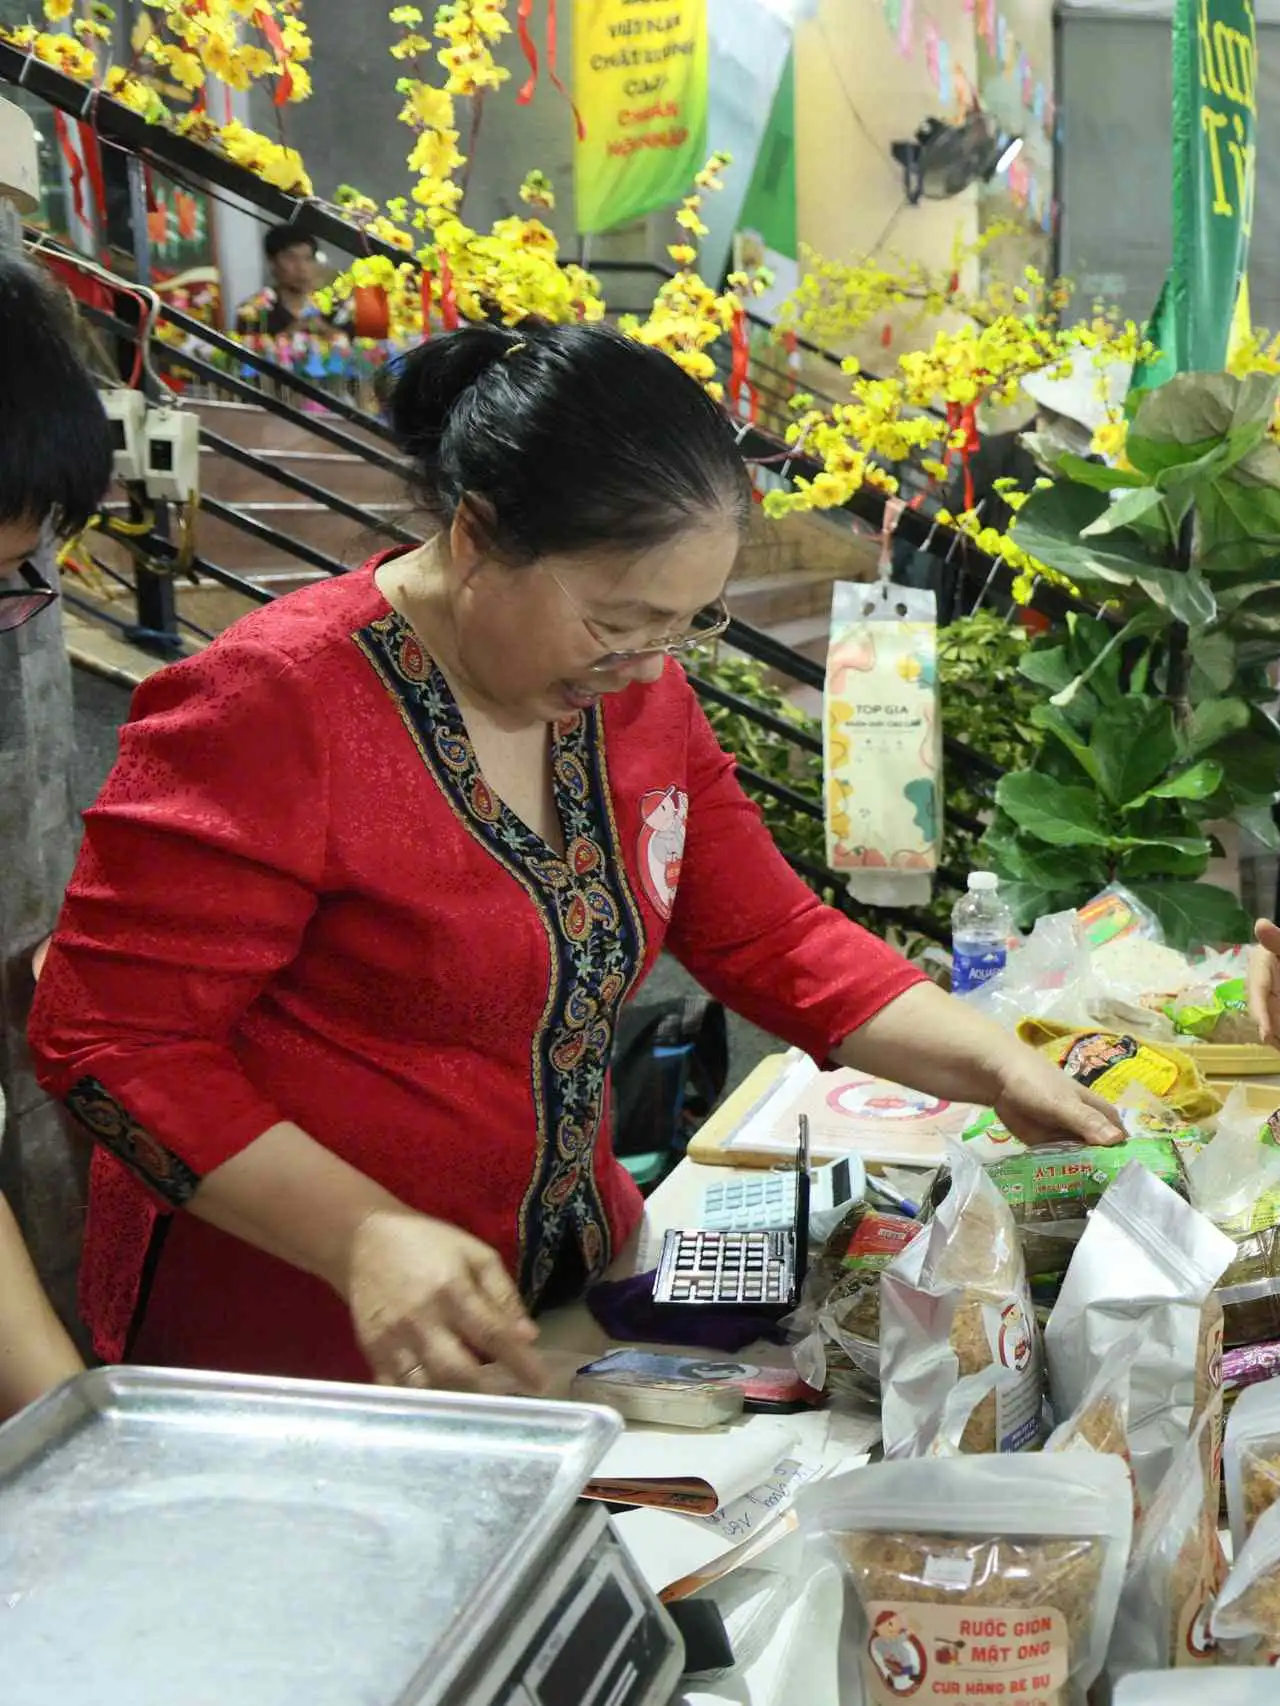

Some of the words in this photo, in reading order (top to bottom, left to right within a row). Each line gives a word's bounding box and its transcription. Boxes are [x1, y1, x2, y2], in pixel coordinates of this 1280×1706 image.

[959, 1616, 1007, 1638] RUỐC
[971, 1644, 1012, 1667] MẬT
[1017, 1641, 1051, 1661] ONG
